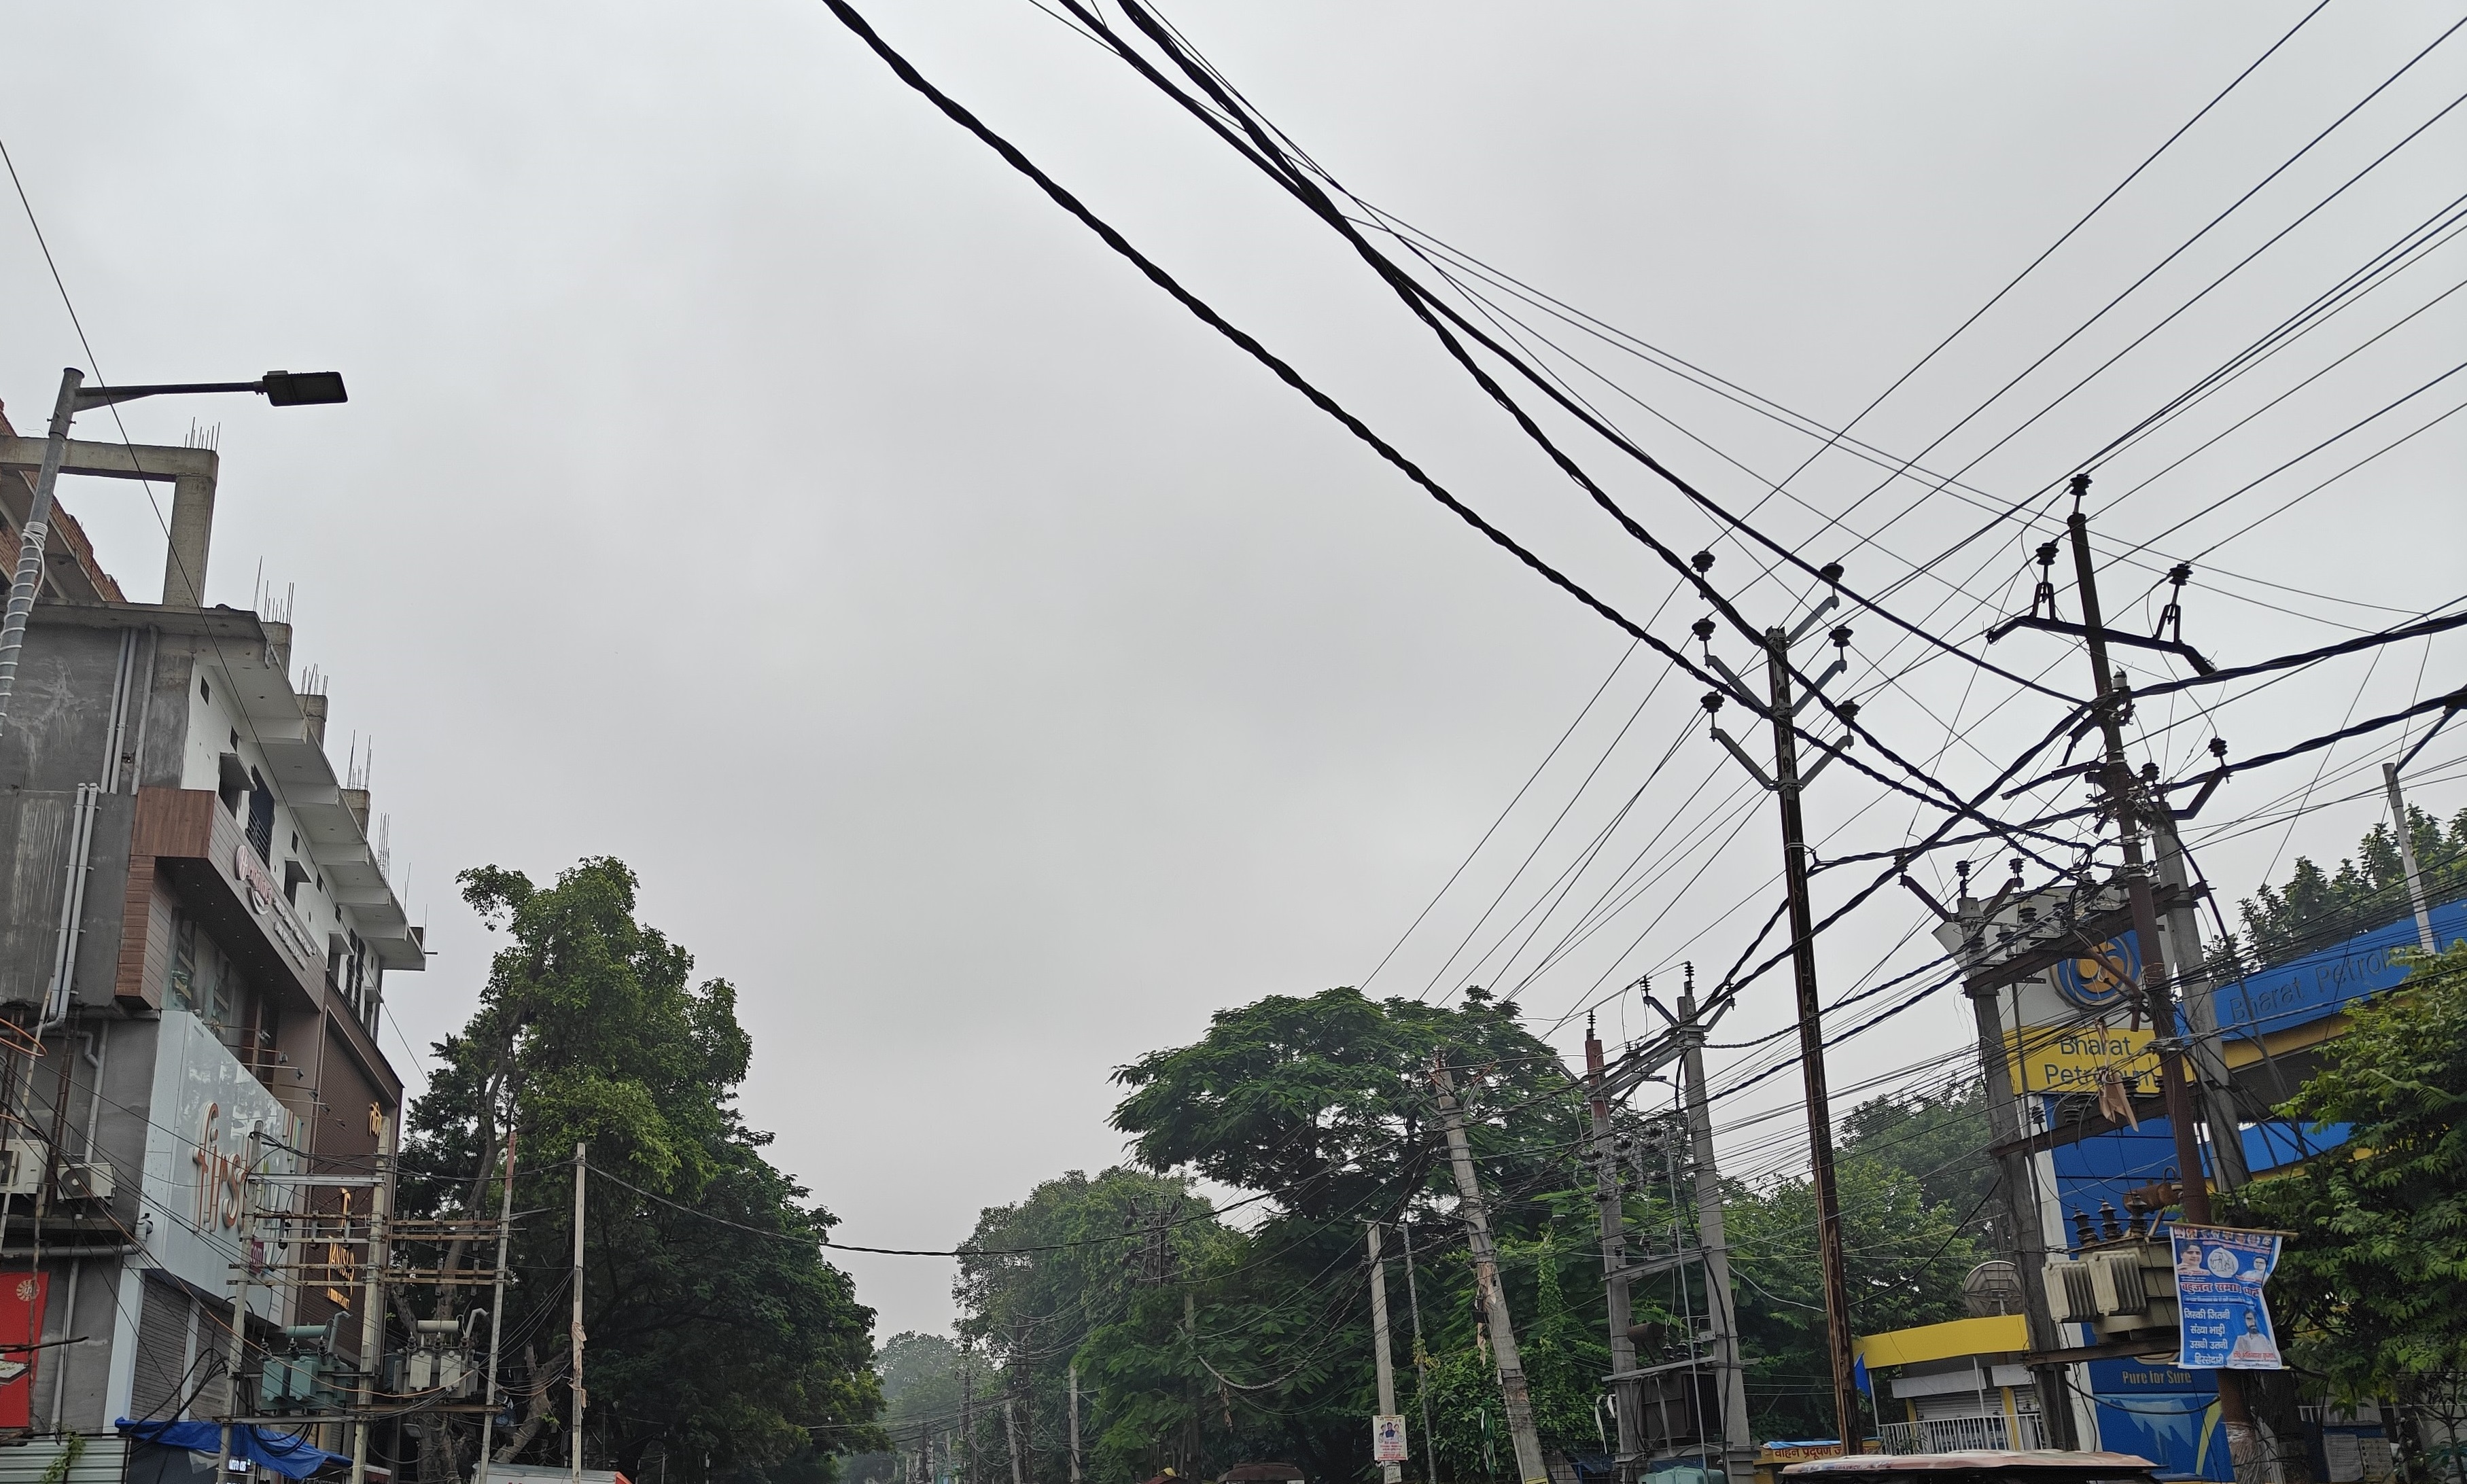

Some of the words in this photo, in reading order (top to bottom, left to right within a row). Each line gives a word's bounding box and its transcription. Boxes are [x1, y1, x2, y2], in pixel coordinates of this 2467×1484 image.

[2207, 1309, 2230, 1320] जितनी
[2209, 1339, 2228, 1349] उतनी
[2122, 1371, 2148, 1384] Pure
[2149, 1370, 2165, 1384] for
[2166, 1370, 2192, 1383] Sure
[1774, 1448, 1800, 1459] वाहन
[1802, 1446, 1832, 1460] प्रदूषण
